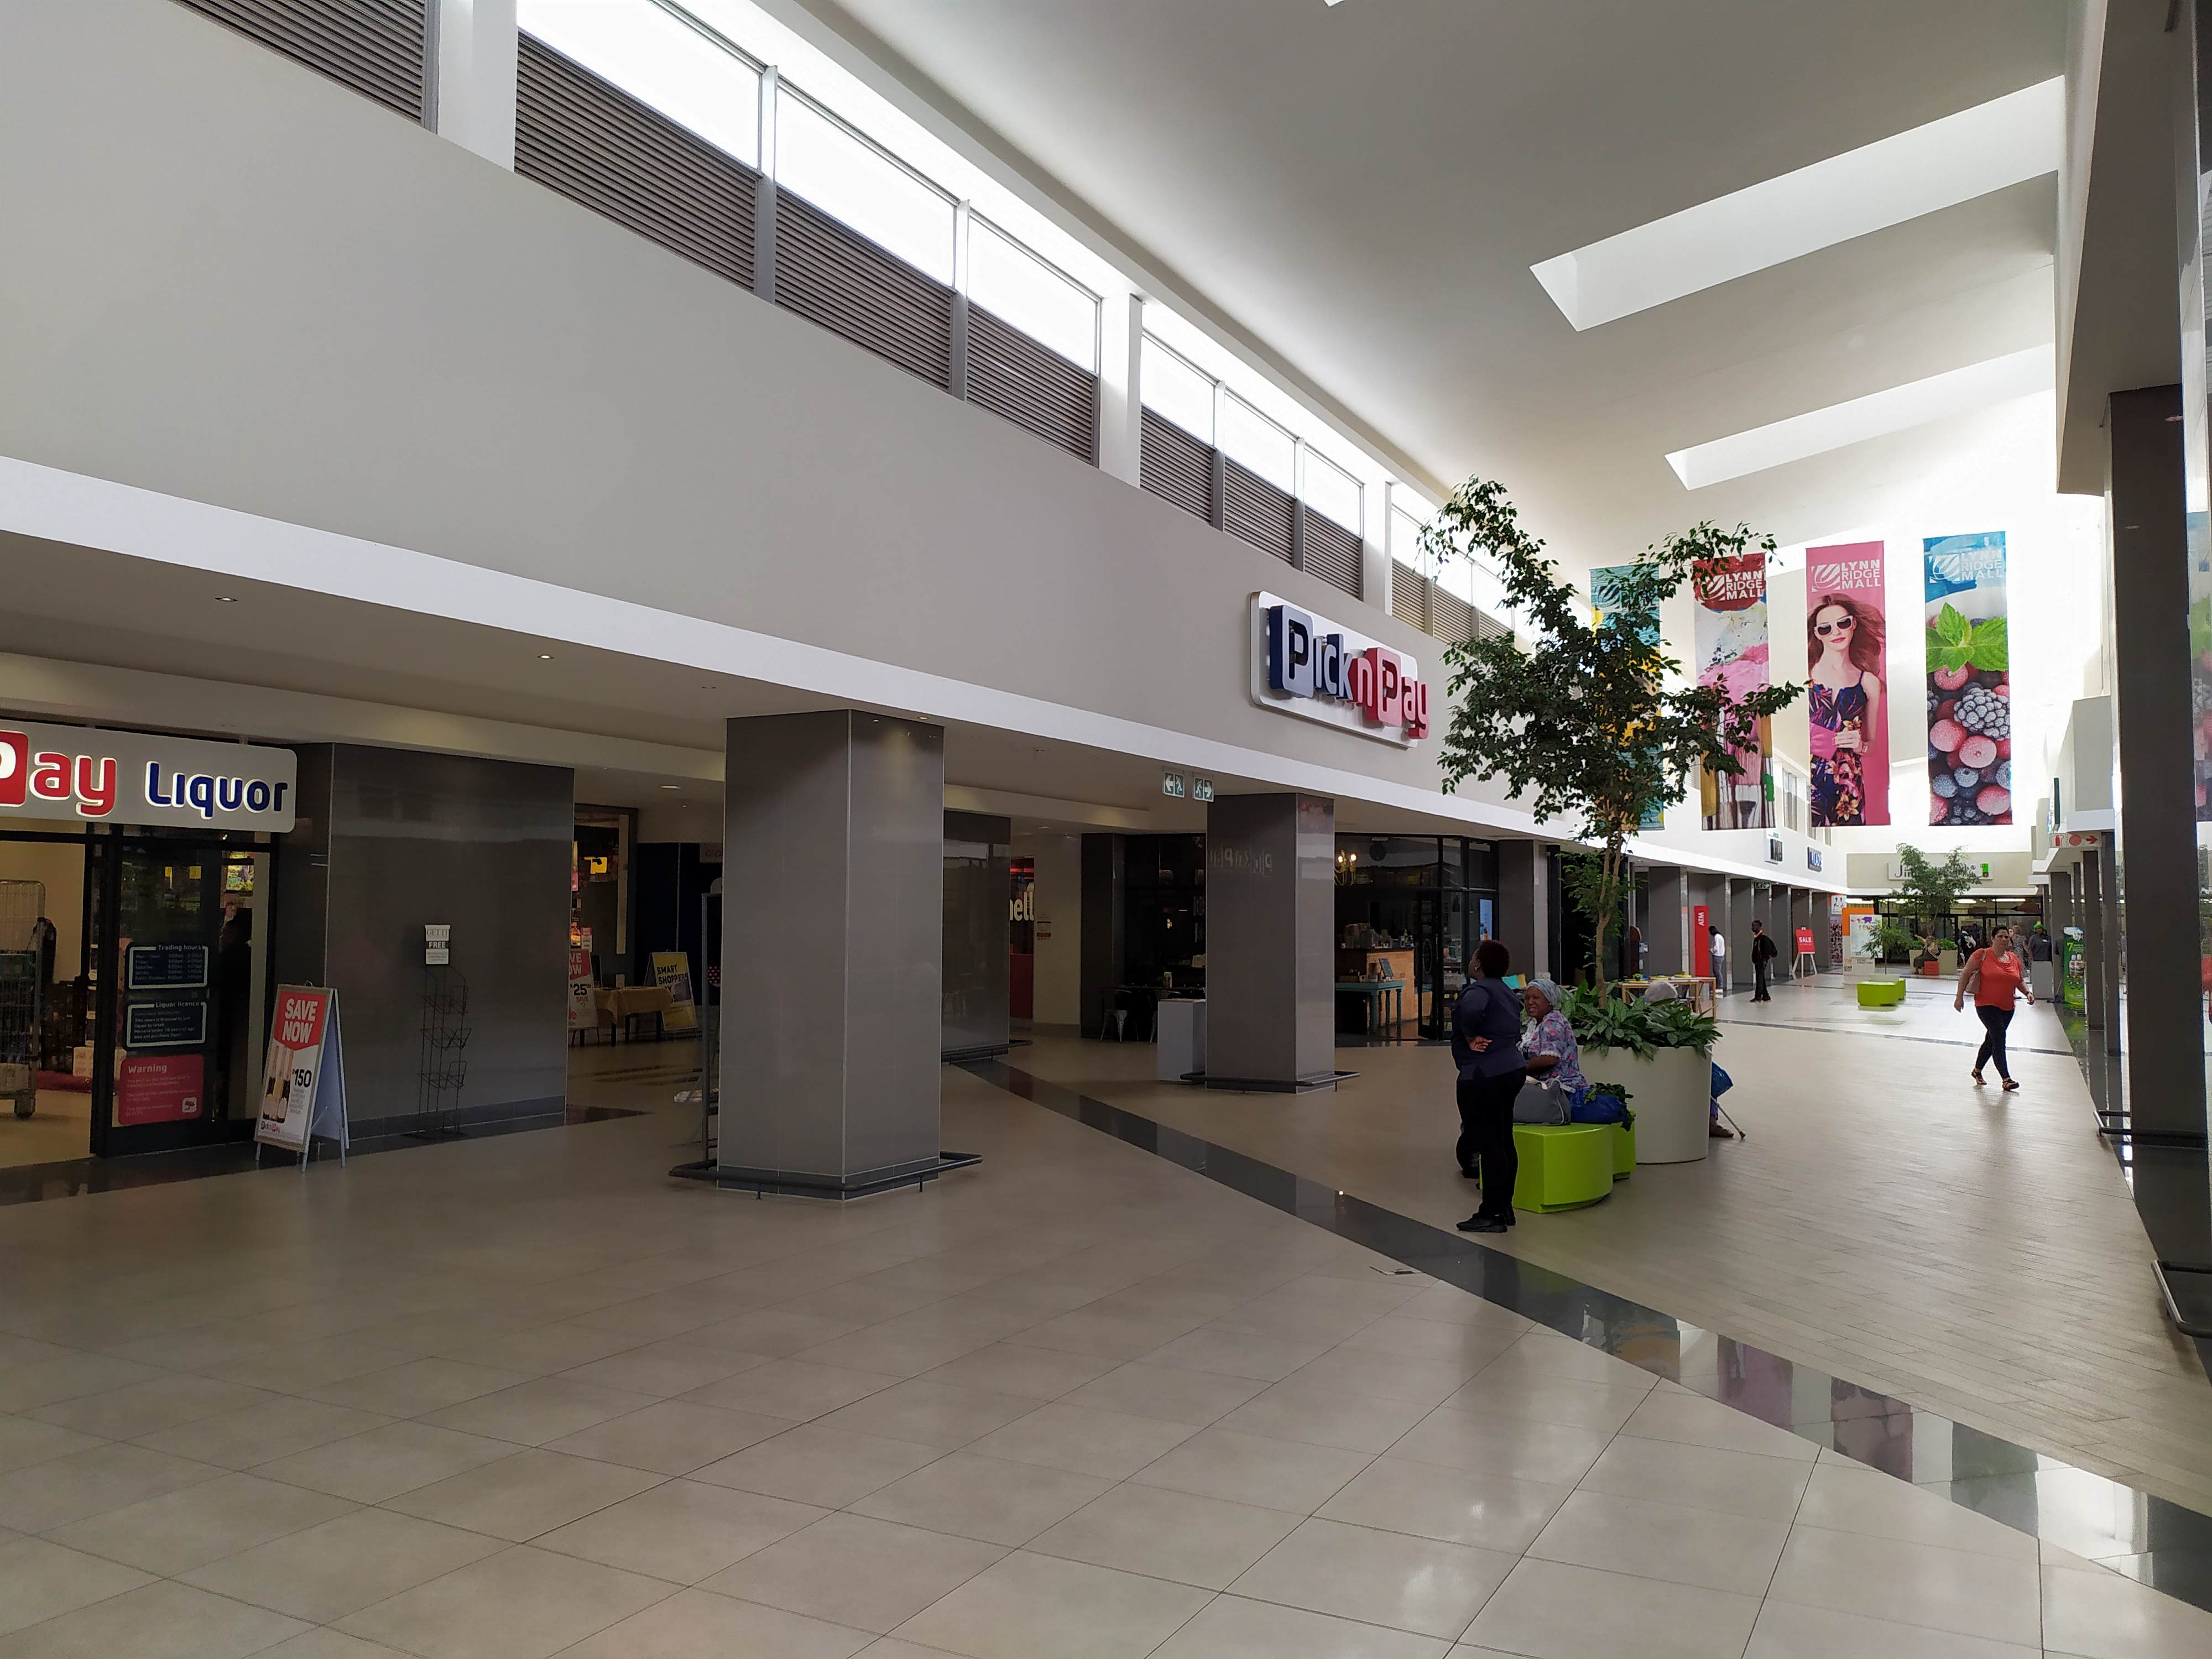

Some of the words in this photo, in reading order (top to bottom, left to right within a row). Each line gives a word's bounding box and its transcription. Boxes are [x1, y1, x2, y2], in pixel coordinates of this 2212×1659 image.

[1961, 549, 2002, 562] LYNN
[1841, 559, 1880, 572] LYNN
[1961, 559, 2002, 571] RIDGE
[1725, 571, 1762, 582] LYNN
[1841, 568, 1881, 581] RIDGE
[1961, 569, 2002, 581] MALL
[1726, 579, 1763, 592] RIDGE
[1842, 578, 1881, 590] MALL
[1726, 588, 1764, 600] MALL
[145, 761, 287, 820] Liquor
[2067, 942, 2074, 952] 7
[657, 964, 677, 975] SMART
[658, 973, 689, 985] SHOPPERS
[285, 998, 318, 1022] SAVE
[282, 1021, 314, 1044] NOW
[128, 1064, 168, 1074] Warning
